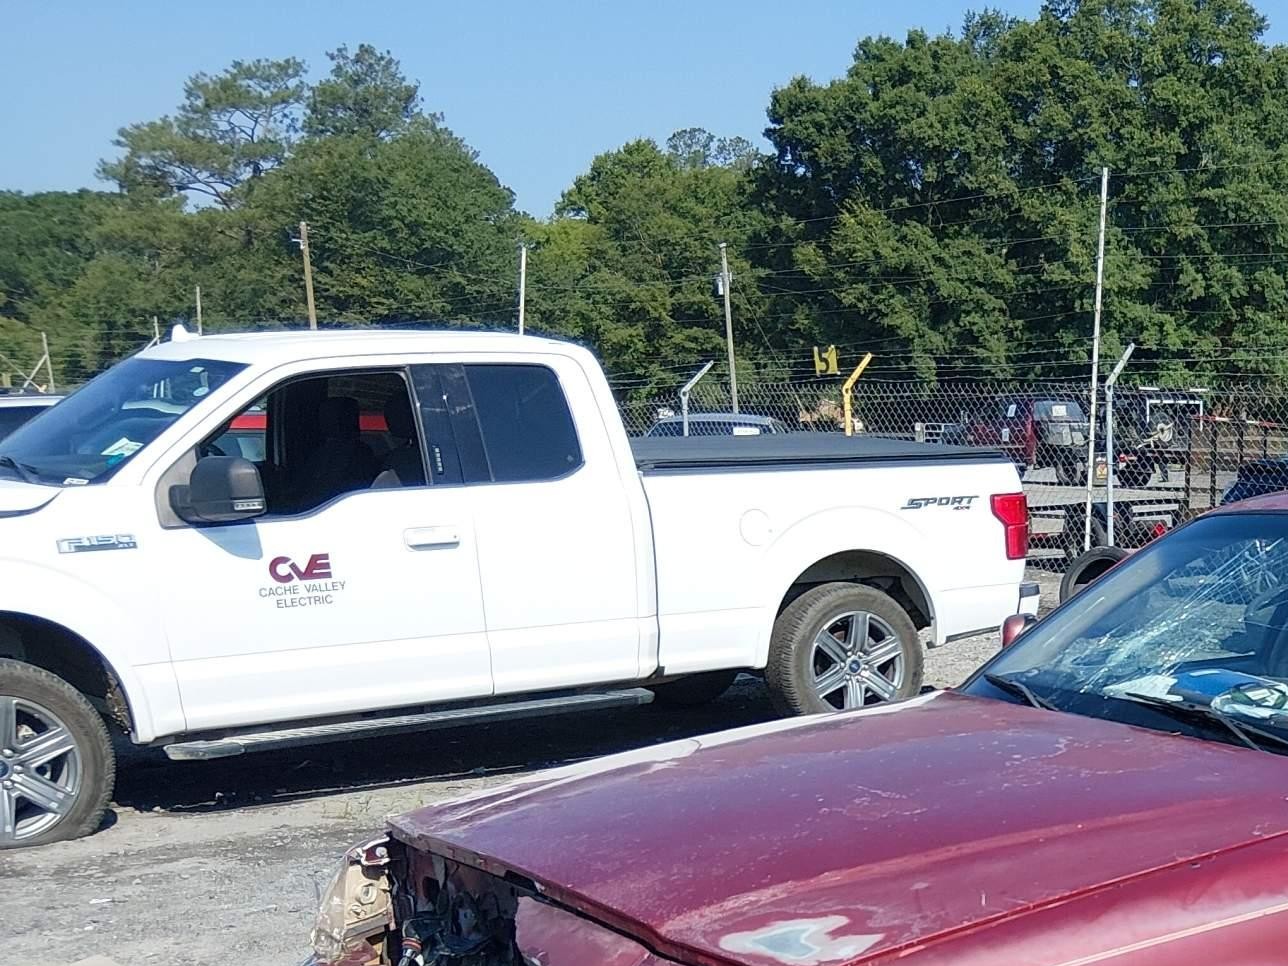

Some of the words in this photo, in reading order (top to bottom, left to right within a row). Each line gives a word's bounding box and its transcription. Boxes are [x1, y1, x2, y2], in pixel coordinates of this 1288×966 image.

[900, 495, 979, 510] SPORT
[269, 553, 332, 583] CVE
[258, 584, 300, 598] CACHE
[304, 580, 346, 594] VALLEY
[276, 594, 334, 609] ELECTRIC
